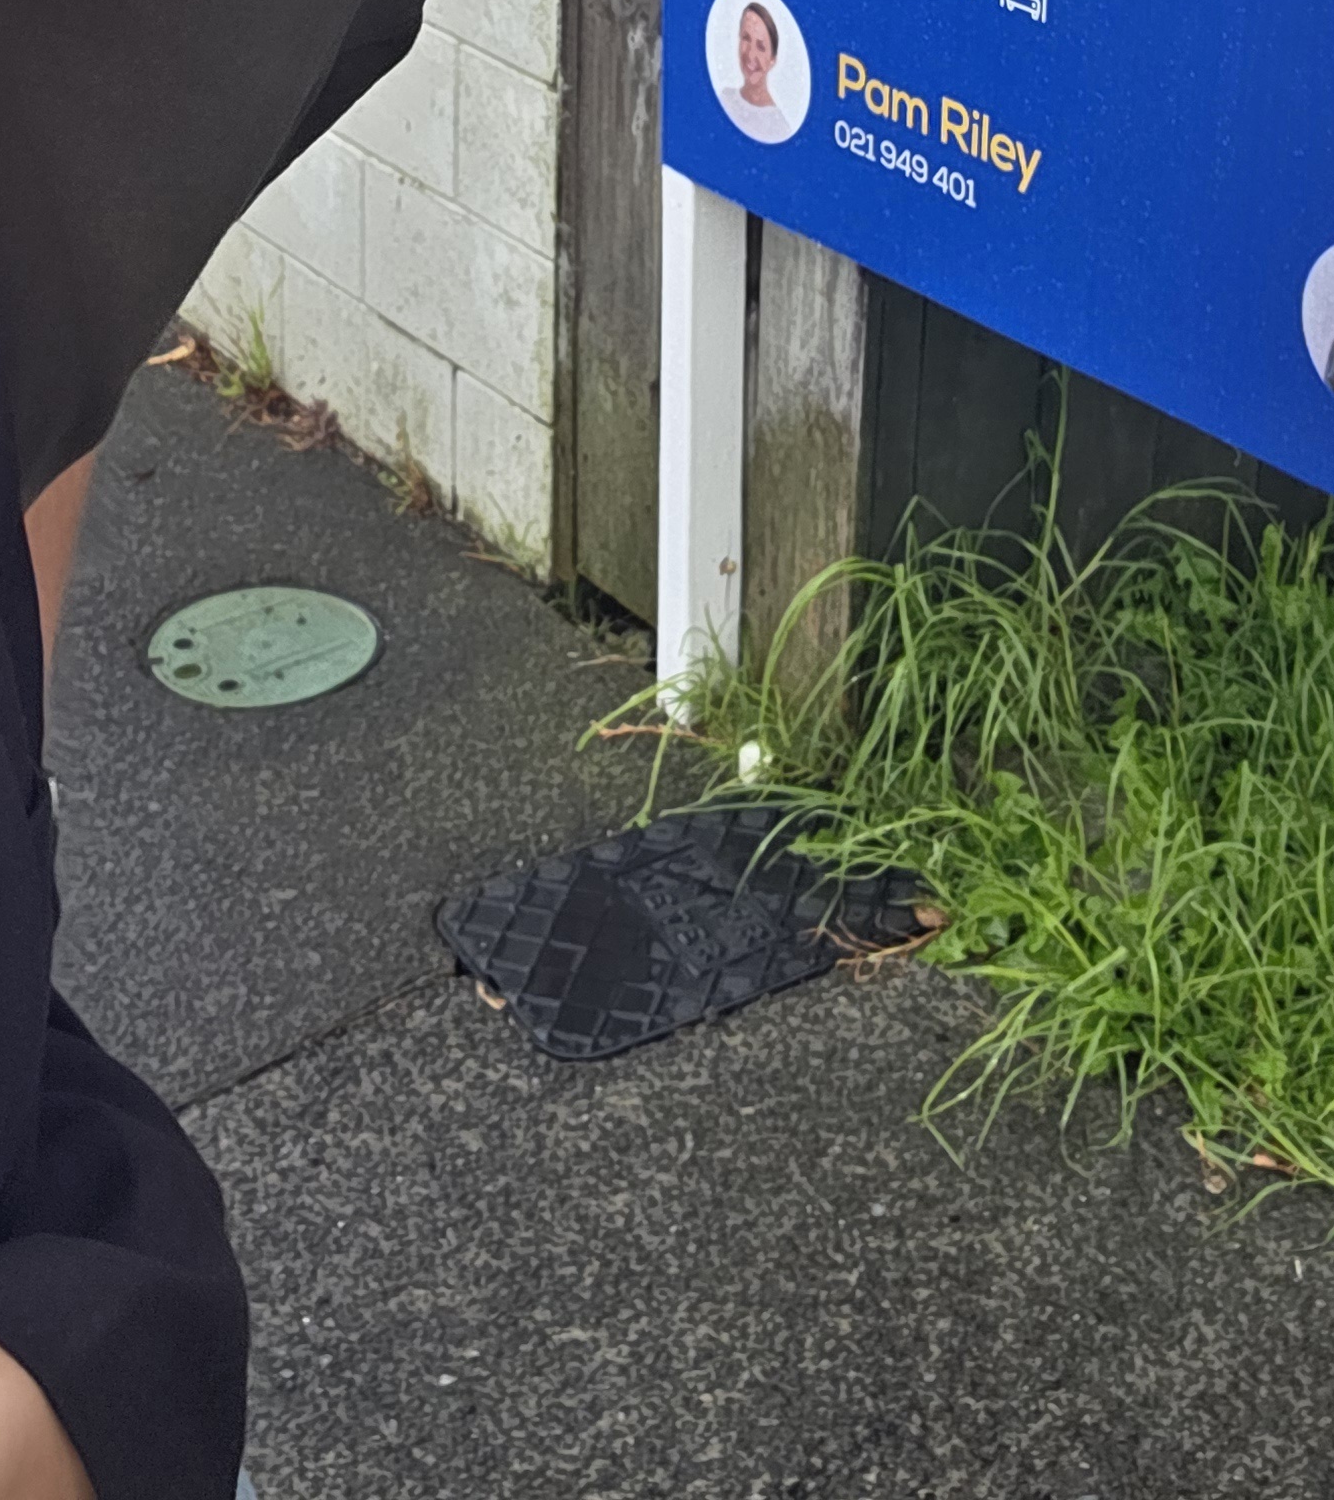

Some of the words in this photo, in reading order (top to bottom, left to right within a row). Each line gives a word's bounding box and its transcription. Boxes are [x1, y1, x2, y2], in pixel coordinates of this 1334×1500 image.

[834, 119, 875, 162] 021
[879, 142, 928, 184] 949
[932, 166, 977, 208] 401
[837, 52, 929, 135] Pam
[940, 96, 1042, 193] Riley
